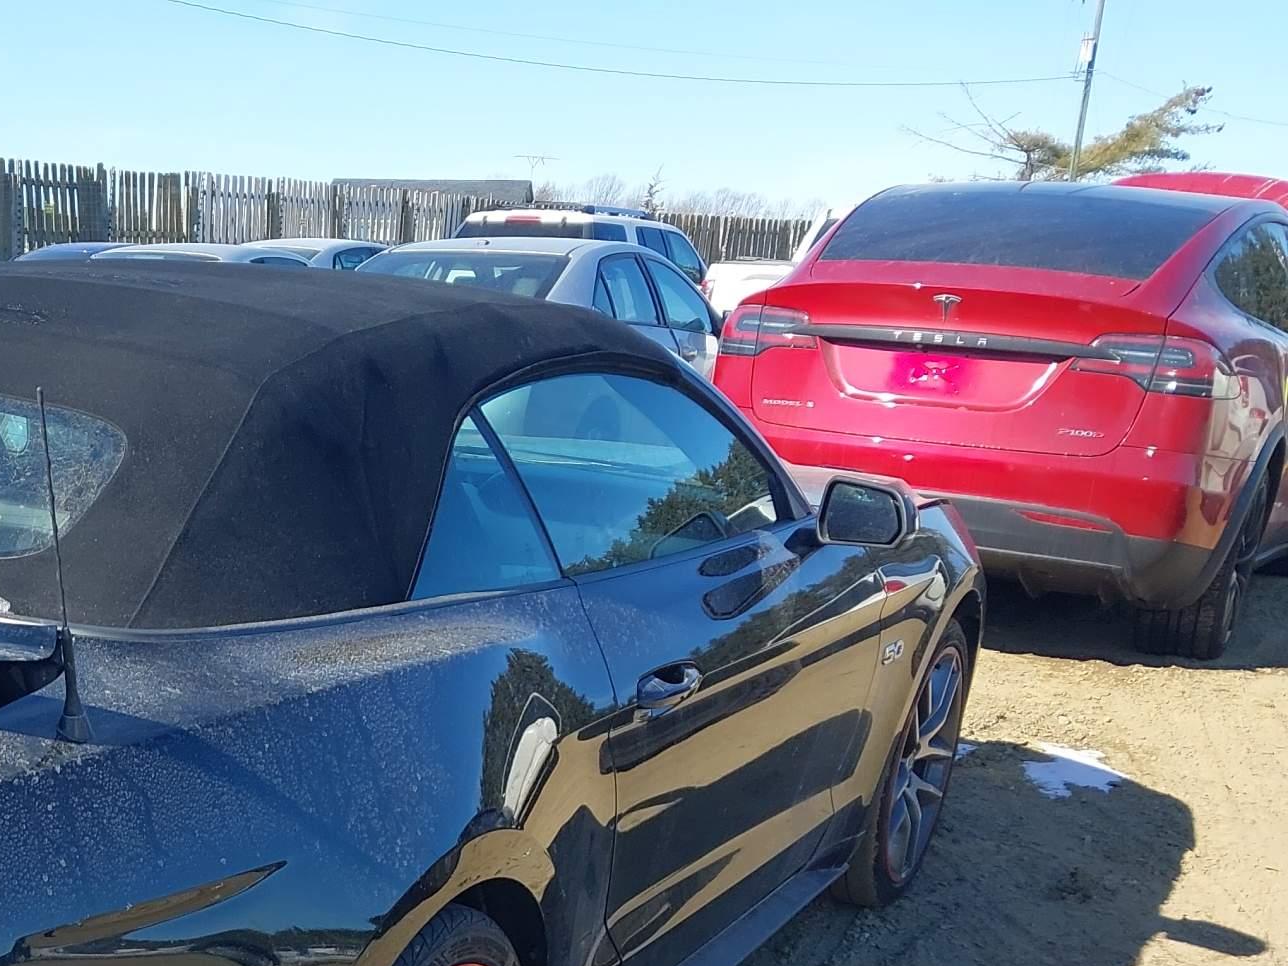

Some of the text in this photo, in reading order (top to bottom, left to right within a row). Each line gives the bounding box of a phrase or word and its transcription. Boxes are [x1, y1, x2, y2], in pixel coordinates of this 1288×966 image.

[893, 330, 987, 346] TESLA
[762, 398, 802, 407] MODEL
[1056, 428, 1105, 438] P100D
